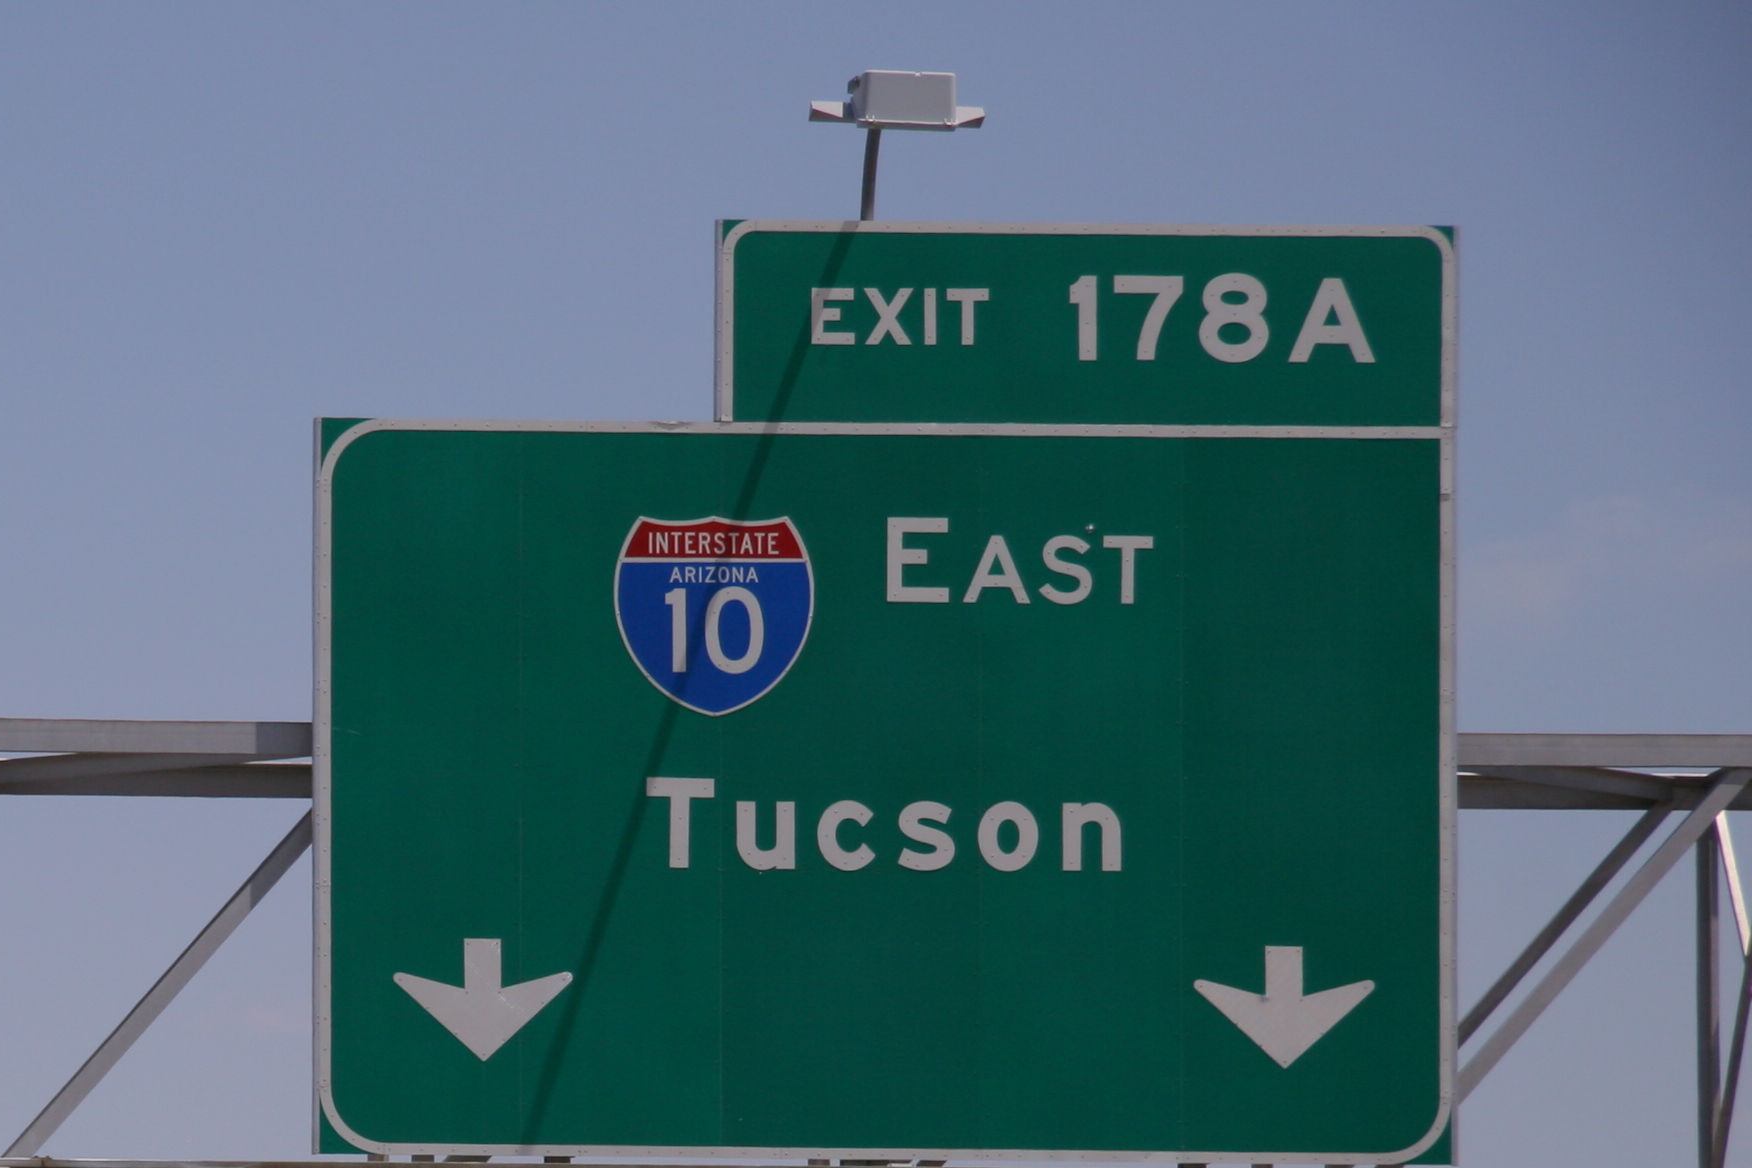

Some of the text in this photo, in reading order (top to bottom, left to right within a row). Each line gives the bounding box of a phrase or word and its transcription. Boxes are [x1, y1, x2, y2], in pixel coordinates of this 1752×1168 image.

[811, 273, 1375, 363] EXIT 178A
[648, 531, 780, 555] INTERSTATE
[669, 566, 759, 584] ARIZONA
[887, 517, 1153, 605] EAST
[665, 586, 764, 674] 10
[647, 777, 1121, 871] Tucson
